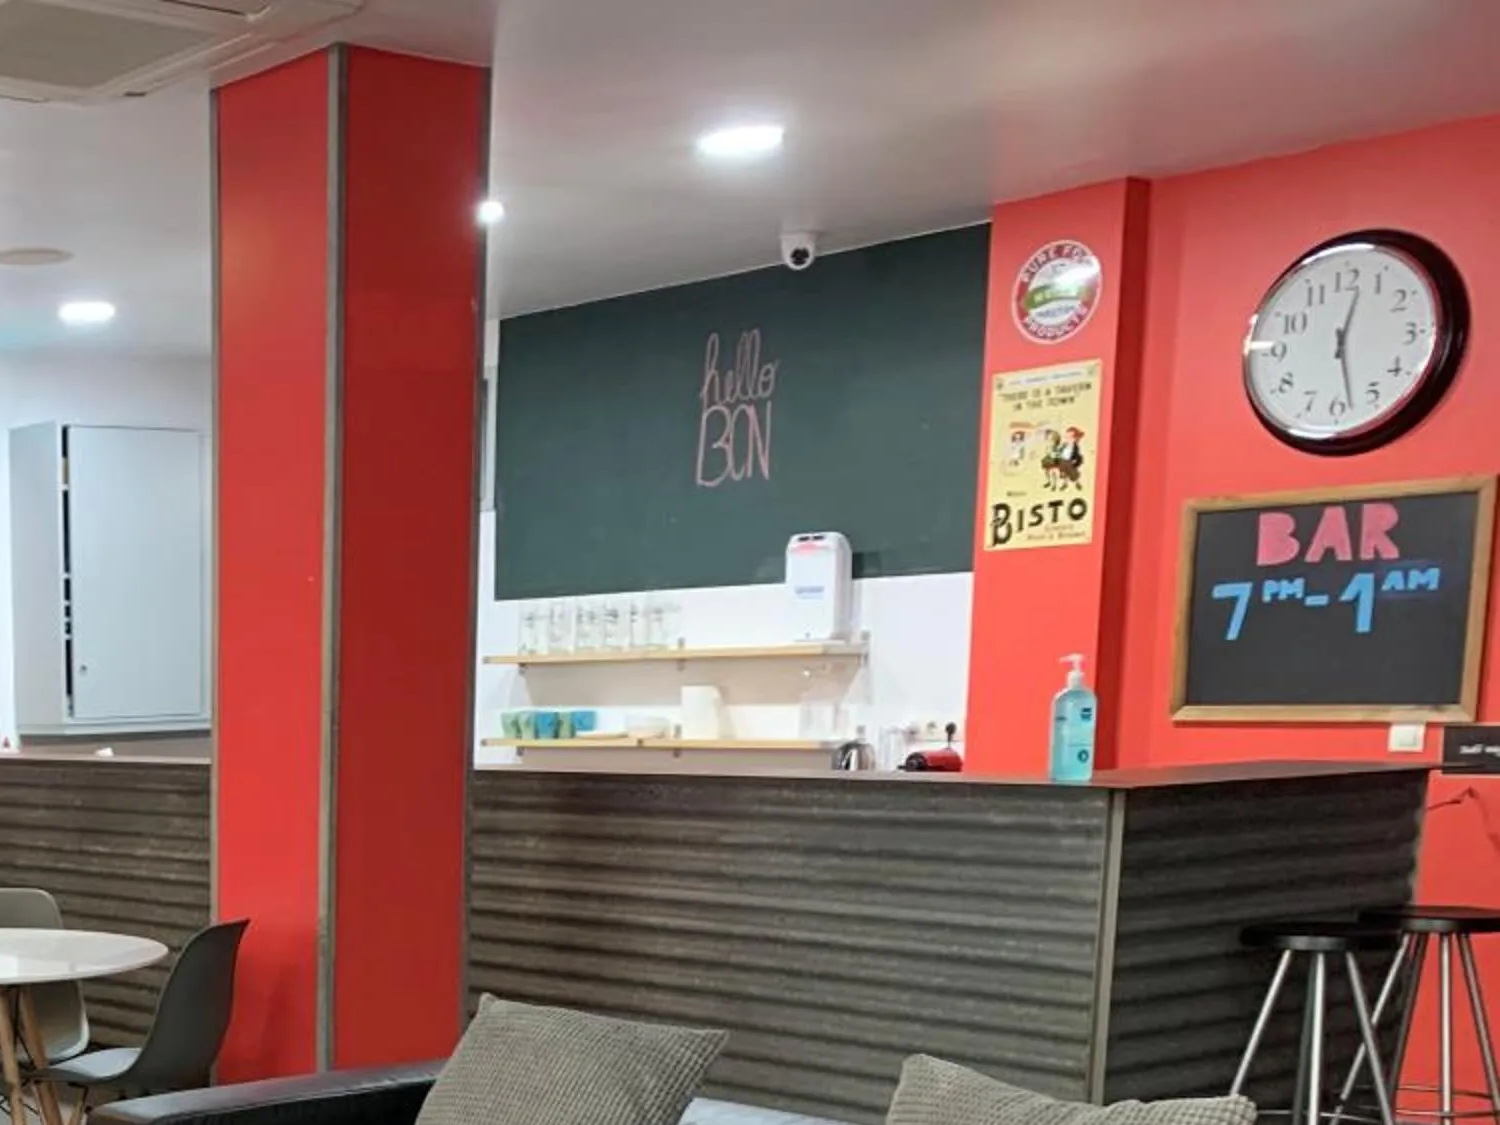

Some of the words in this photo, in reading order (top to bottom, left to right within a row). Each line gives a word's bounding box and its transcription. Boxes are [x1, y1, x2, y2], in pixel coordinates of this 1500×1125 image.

[1334, 268, 1360, 293] 12
[1374, 272, 1382, 294] 1
[1306, 284, 1326, 307] 11
[1391, 288, 1407, 312] 2
[1283, 311, 1308, 335] 10
[1403, 321, 1418, 345] 3
[1269, 340, 1288, 363] 9
[700, 328, 781, 412] hello
[1386, 355, 1403, 377] 4
[1278, 372, 1295, 394] 8
[1365, 381, 1381, 405] 5
[1304, 390, 1318, 412] 7
[1328, 396, 1347, 418] 6
[991, 497, 1088, 546] BISTO
[1256, 502, 1400, 567] BAR
